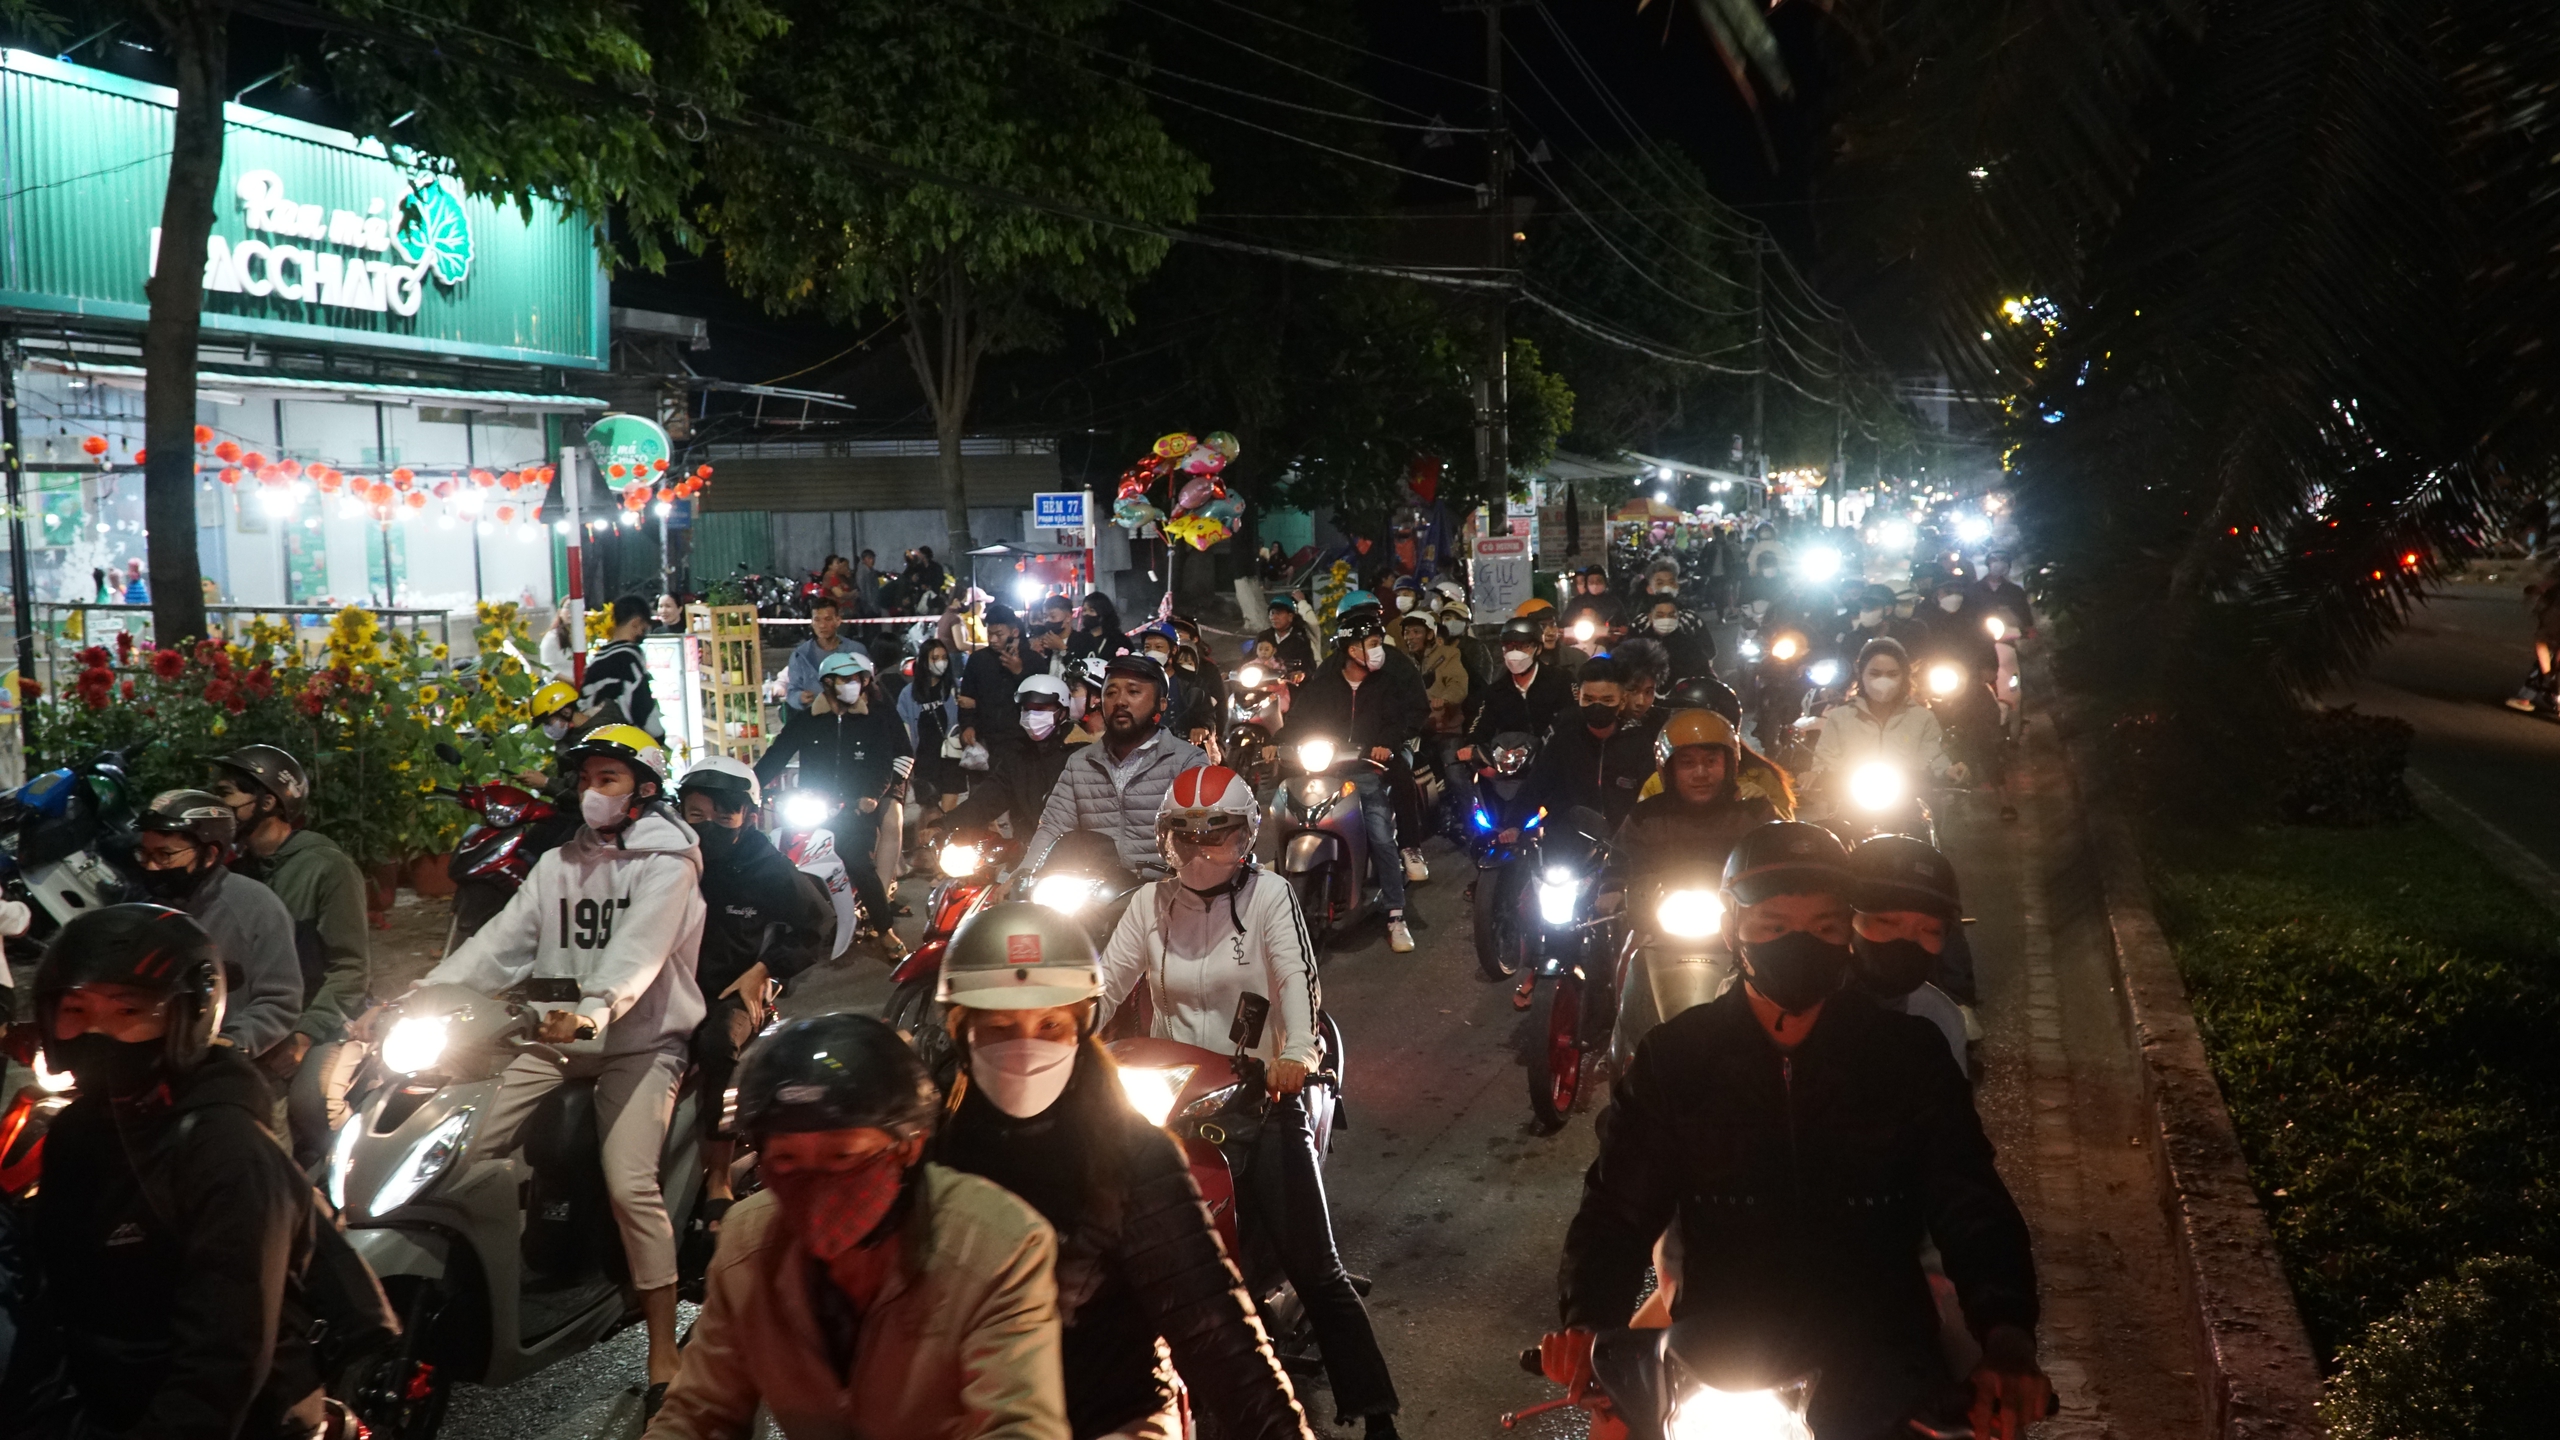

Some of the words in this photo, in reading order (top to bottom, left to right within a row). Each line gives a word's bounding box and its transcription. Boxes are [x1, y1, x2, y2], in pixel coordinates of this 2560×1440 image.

[328, 198, 390, 252] má
[149, 226, 421, 317] ACCHIATO
[1067, 501, 1079, 513] 77
[1482, 585, 1513, 605] XE
